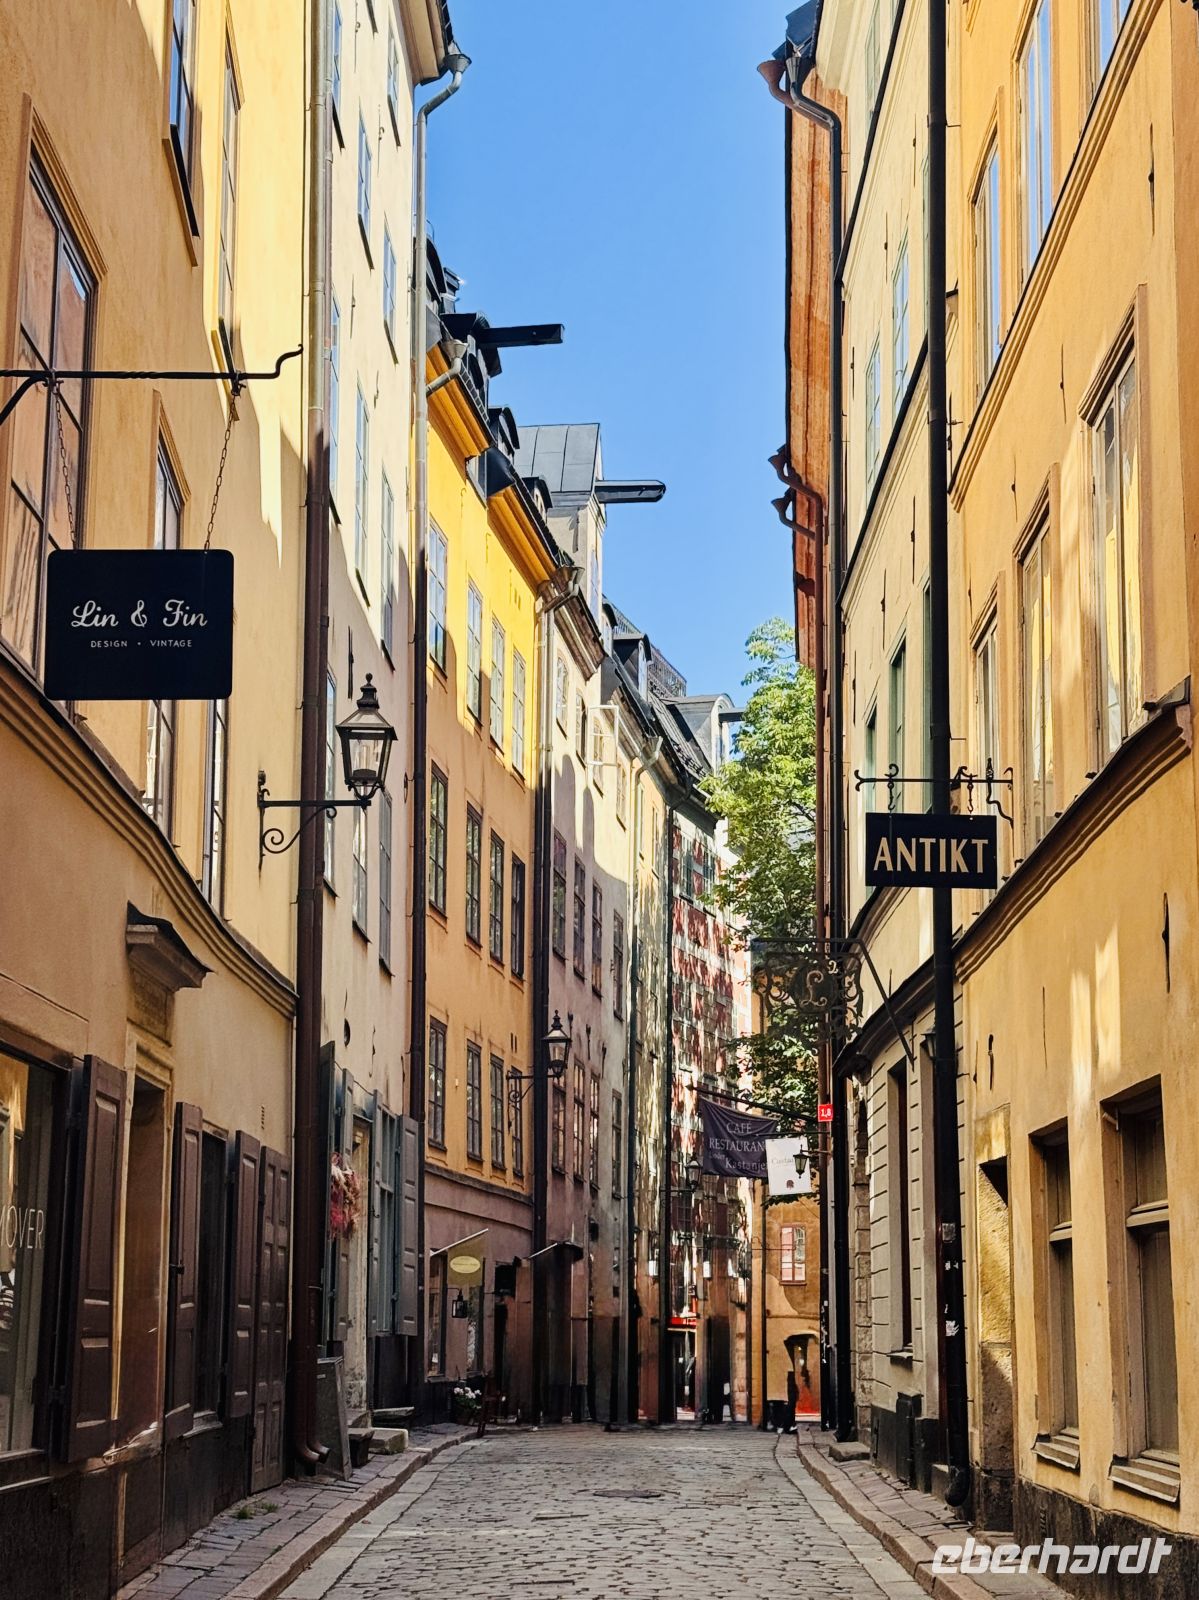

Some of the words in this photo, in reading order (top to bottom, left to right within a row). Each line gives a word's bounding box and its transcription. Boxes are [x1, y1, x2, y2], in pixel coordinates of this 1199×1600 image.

[71, 600, 119, 627] Lin
[130, 600, 147, 627] &
[162, 599, 208, 627] Fin
[90, 640, 128, 648] DESIGN
[149, 639, 193, 648] VINTAGE
[873, 837, 989, 874] ANTIKT
[726, 1121, 753, 1134] CAFÉ
[709, 1137, 766, 1152] RESTAURAN
[725, 1157, 769, 1174] Kastanje
